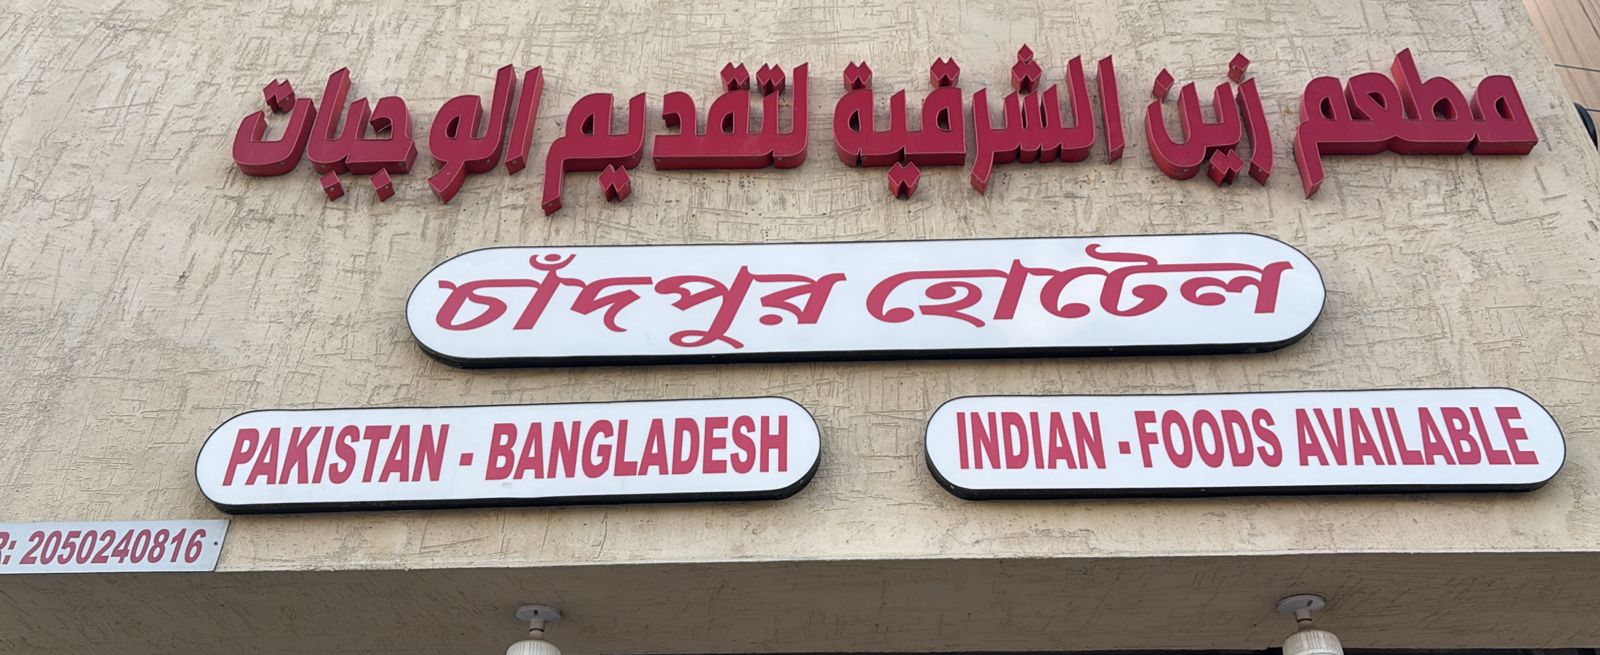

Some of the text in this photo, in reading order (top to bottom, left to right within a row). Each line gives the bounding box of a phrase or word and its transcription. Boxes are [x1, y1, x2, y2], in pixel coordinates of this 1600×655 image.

[233, 44, 1538, 215] مطعم زين الشرقية لتقديم الوجبات
[436, 243, 1293, 349] চাঁদপুর হোটেল
[223, 424, 449, 487] PAKISTAN
[485, 415, 788, 481] BANGLADESH
[956, 411, 1106, 470] INDIAN
[1296, 406, 1539, 467] AVAILABLE
[20, 528, 207, 565] 2050240816
